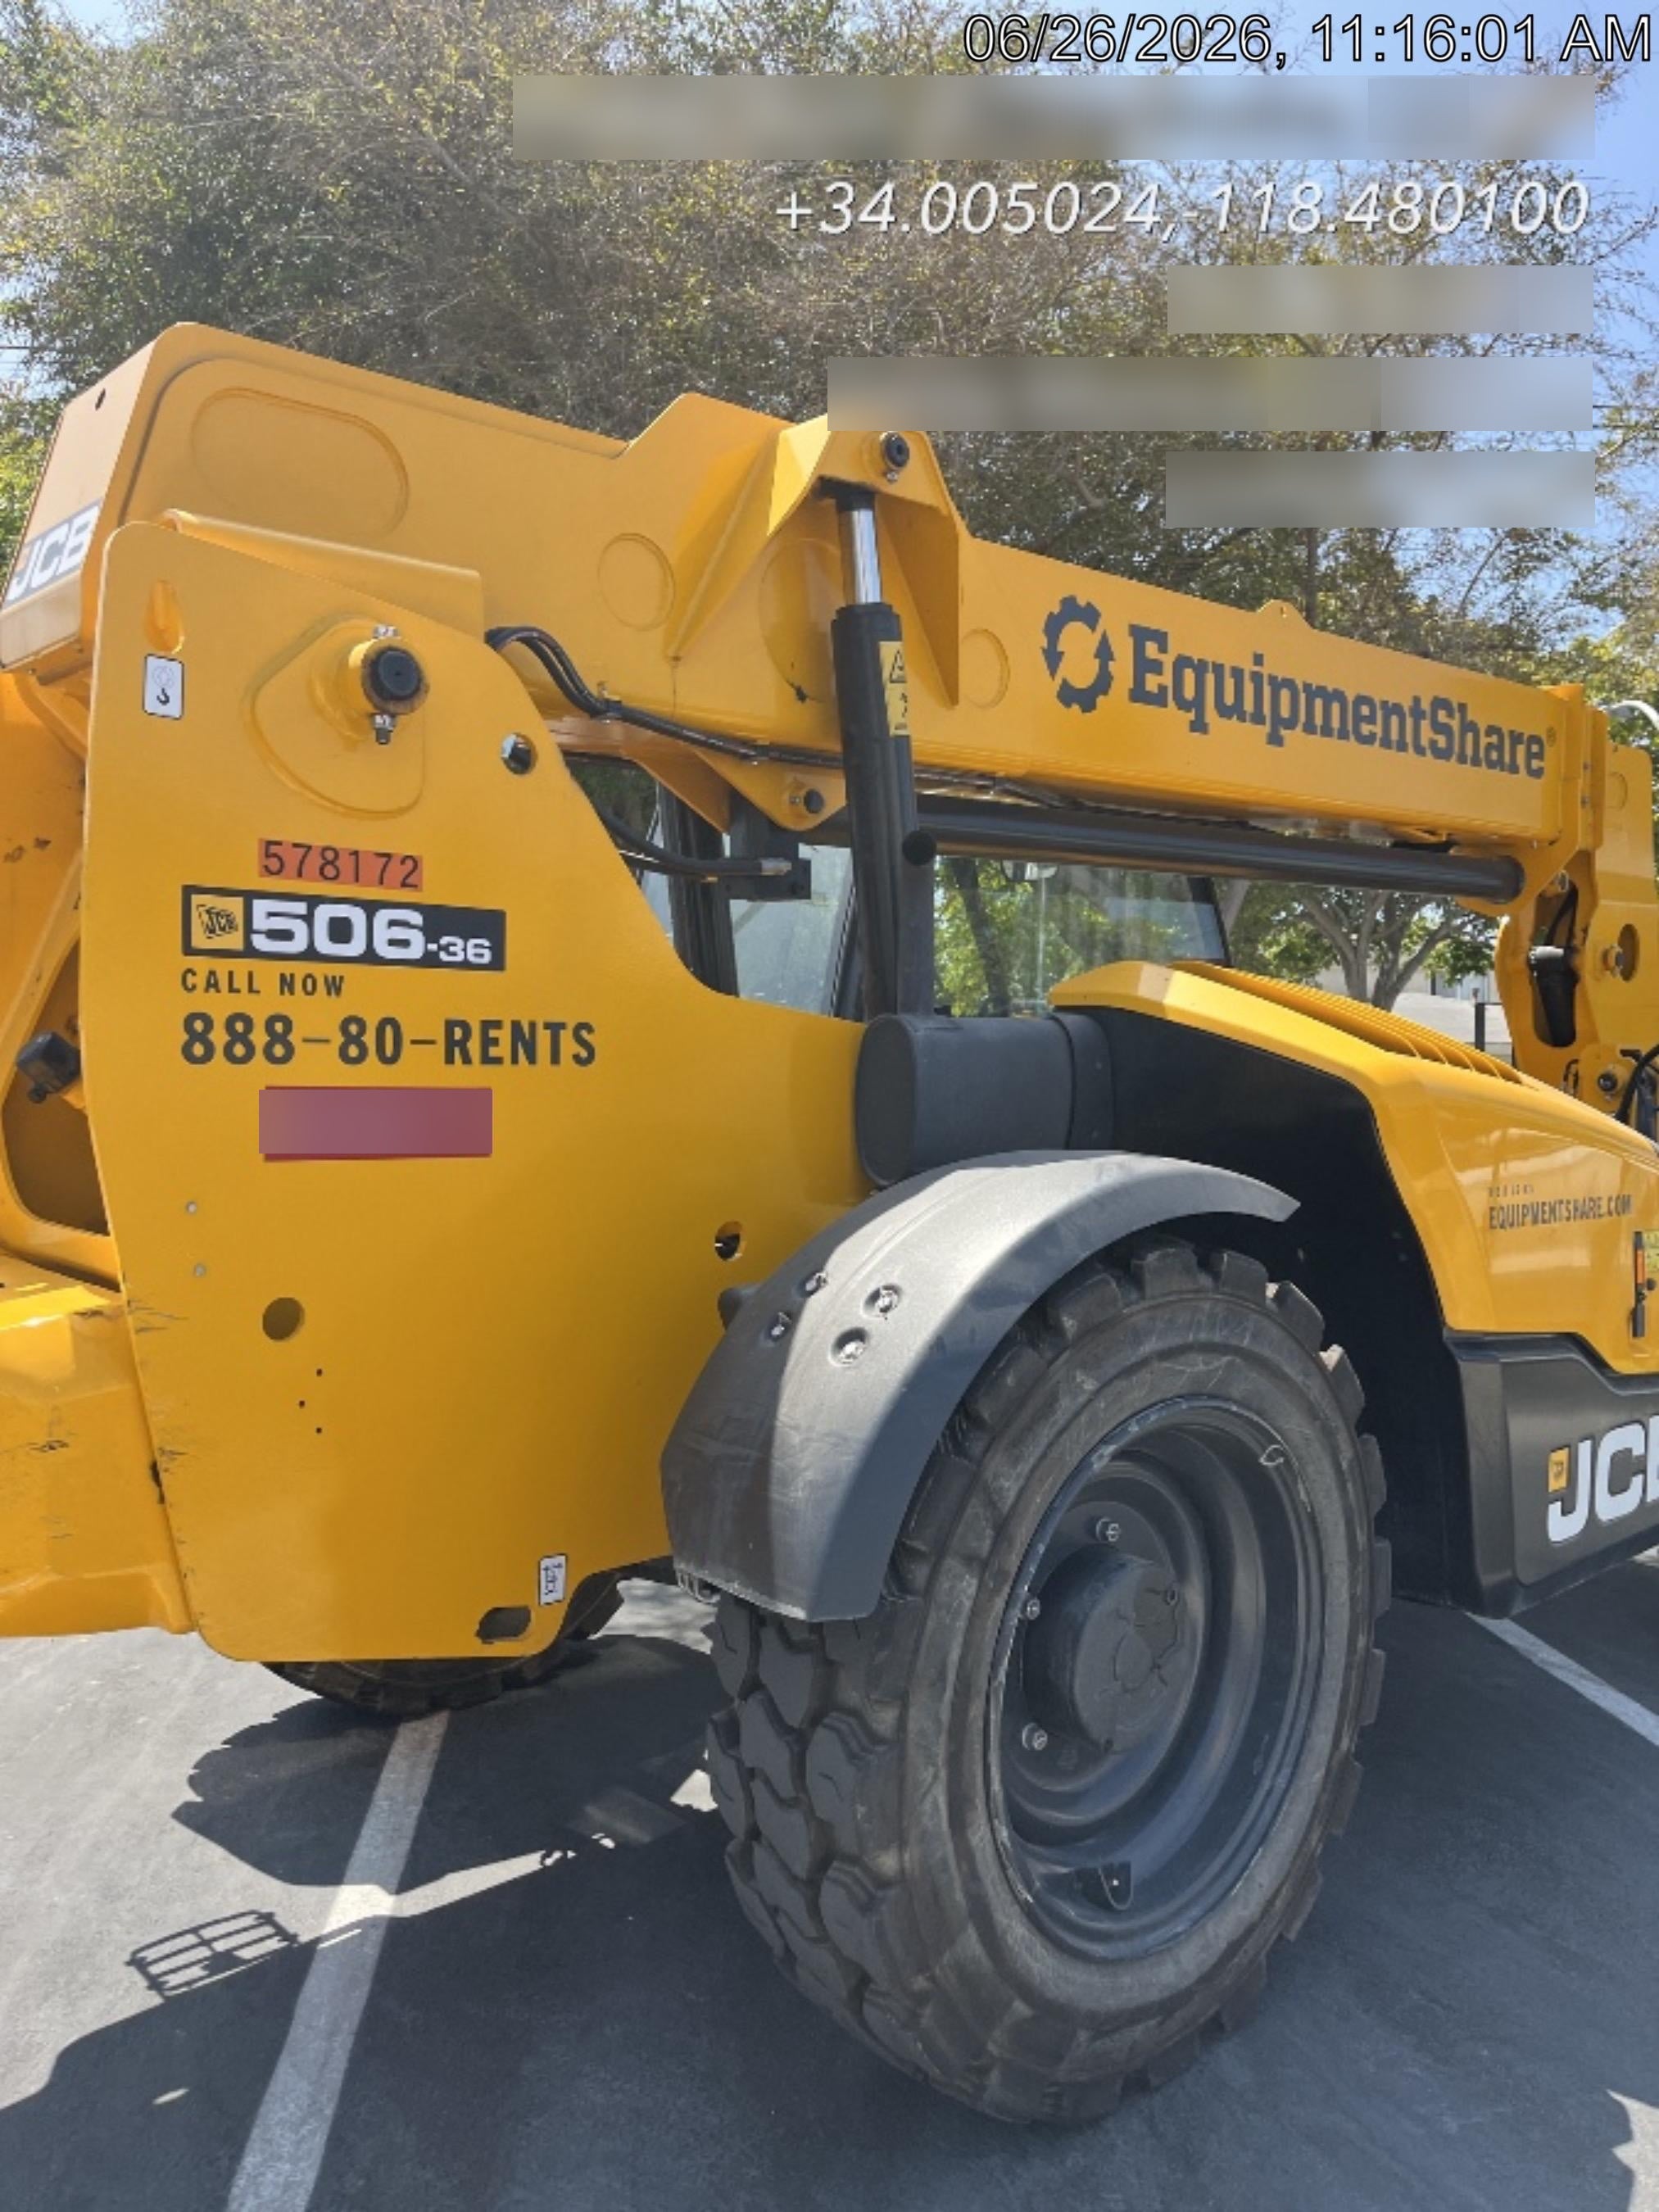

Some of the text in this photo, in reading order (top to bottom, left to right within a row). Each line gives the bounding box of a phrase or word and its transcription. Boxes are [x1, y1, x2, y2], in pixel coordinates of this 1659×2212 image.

[4, 504, 100, 601] JCB
[263, 840, 419, 889] 578172
[181, 968, 345, 997] CALL NOW
[1548, 1414, 1659, 1542] JC
